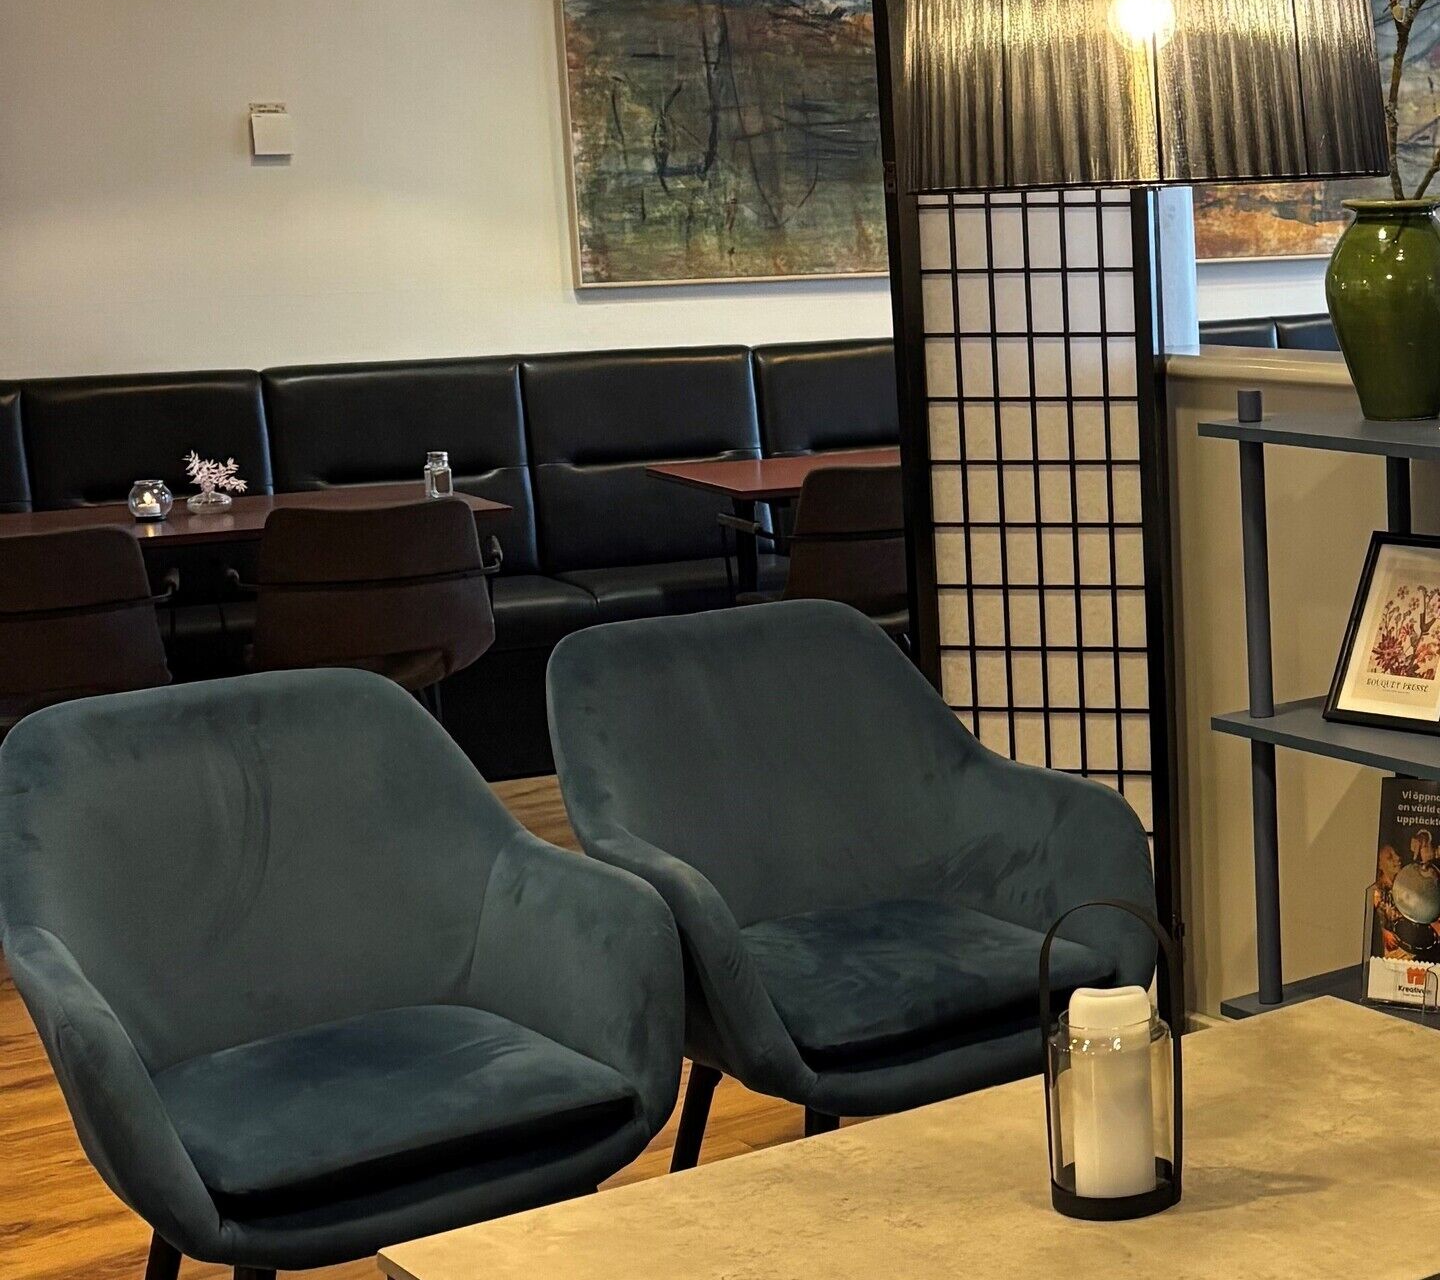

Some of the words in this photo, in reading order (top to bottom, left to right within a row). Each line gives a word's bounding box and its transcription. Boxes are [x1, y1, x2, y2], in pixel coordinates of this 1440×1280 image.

[1366, 678, 1401, 689] BOUQUET
[1402, 790, 1412, 799] Vi
[1411, 804, 1436, 813] värld
